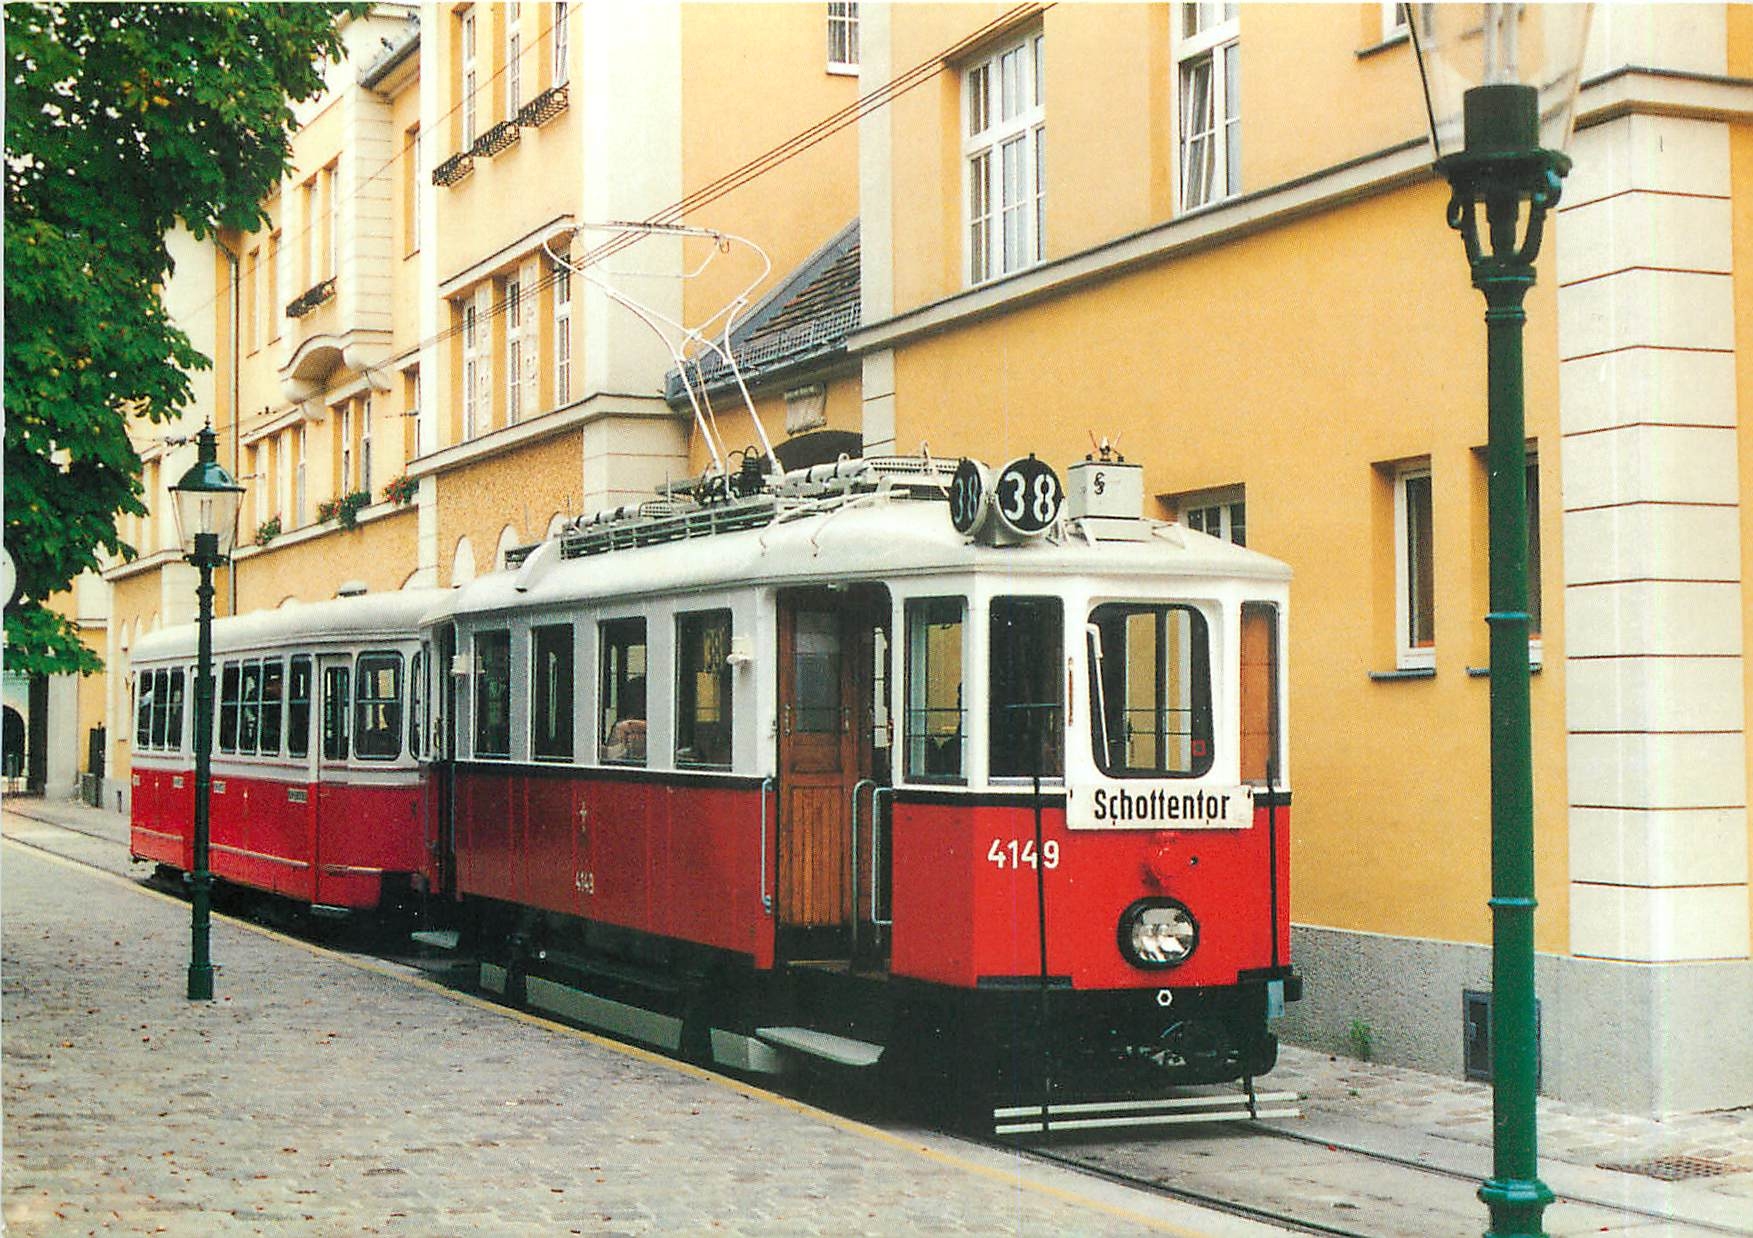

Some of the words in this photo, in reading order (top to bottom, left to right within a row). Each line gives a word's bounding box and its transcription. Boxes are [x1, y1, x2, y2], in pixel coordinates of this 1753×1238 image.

[954, 474, 978, 523] 38
[1004, 471, 1056, 522] 38
[1094, 788, 1230, 820] Schottentor
[987, 838, 1060, 869] 4149
[575, 871, 594, 894] 4149
